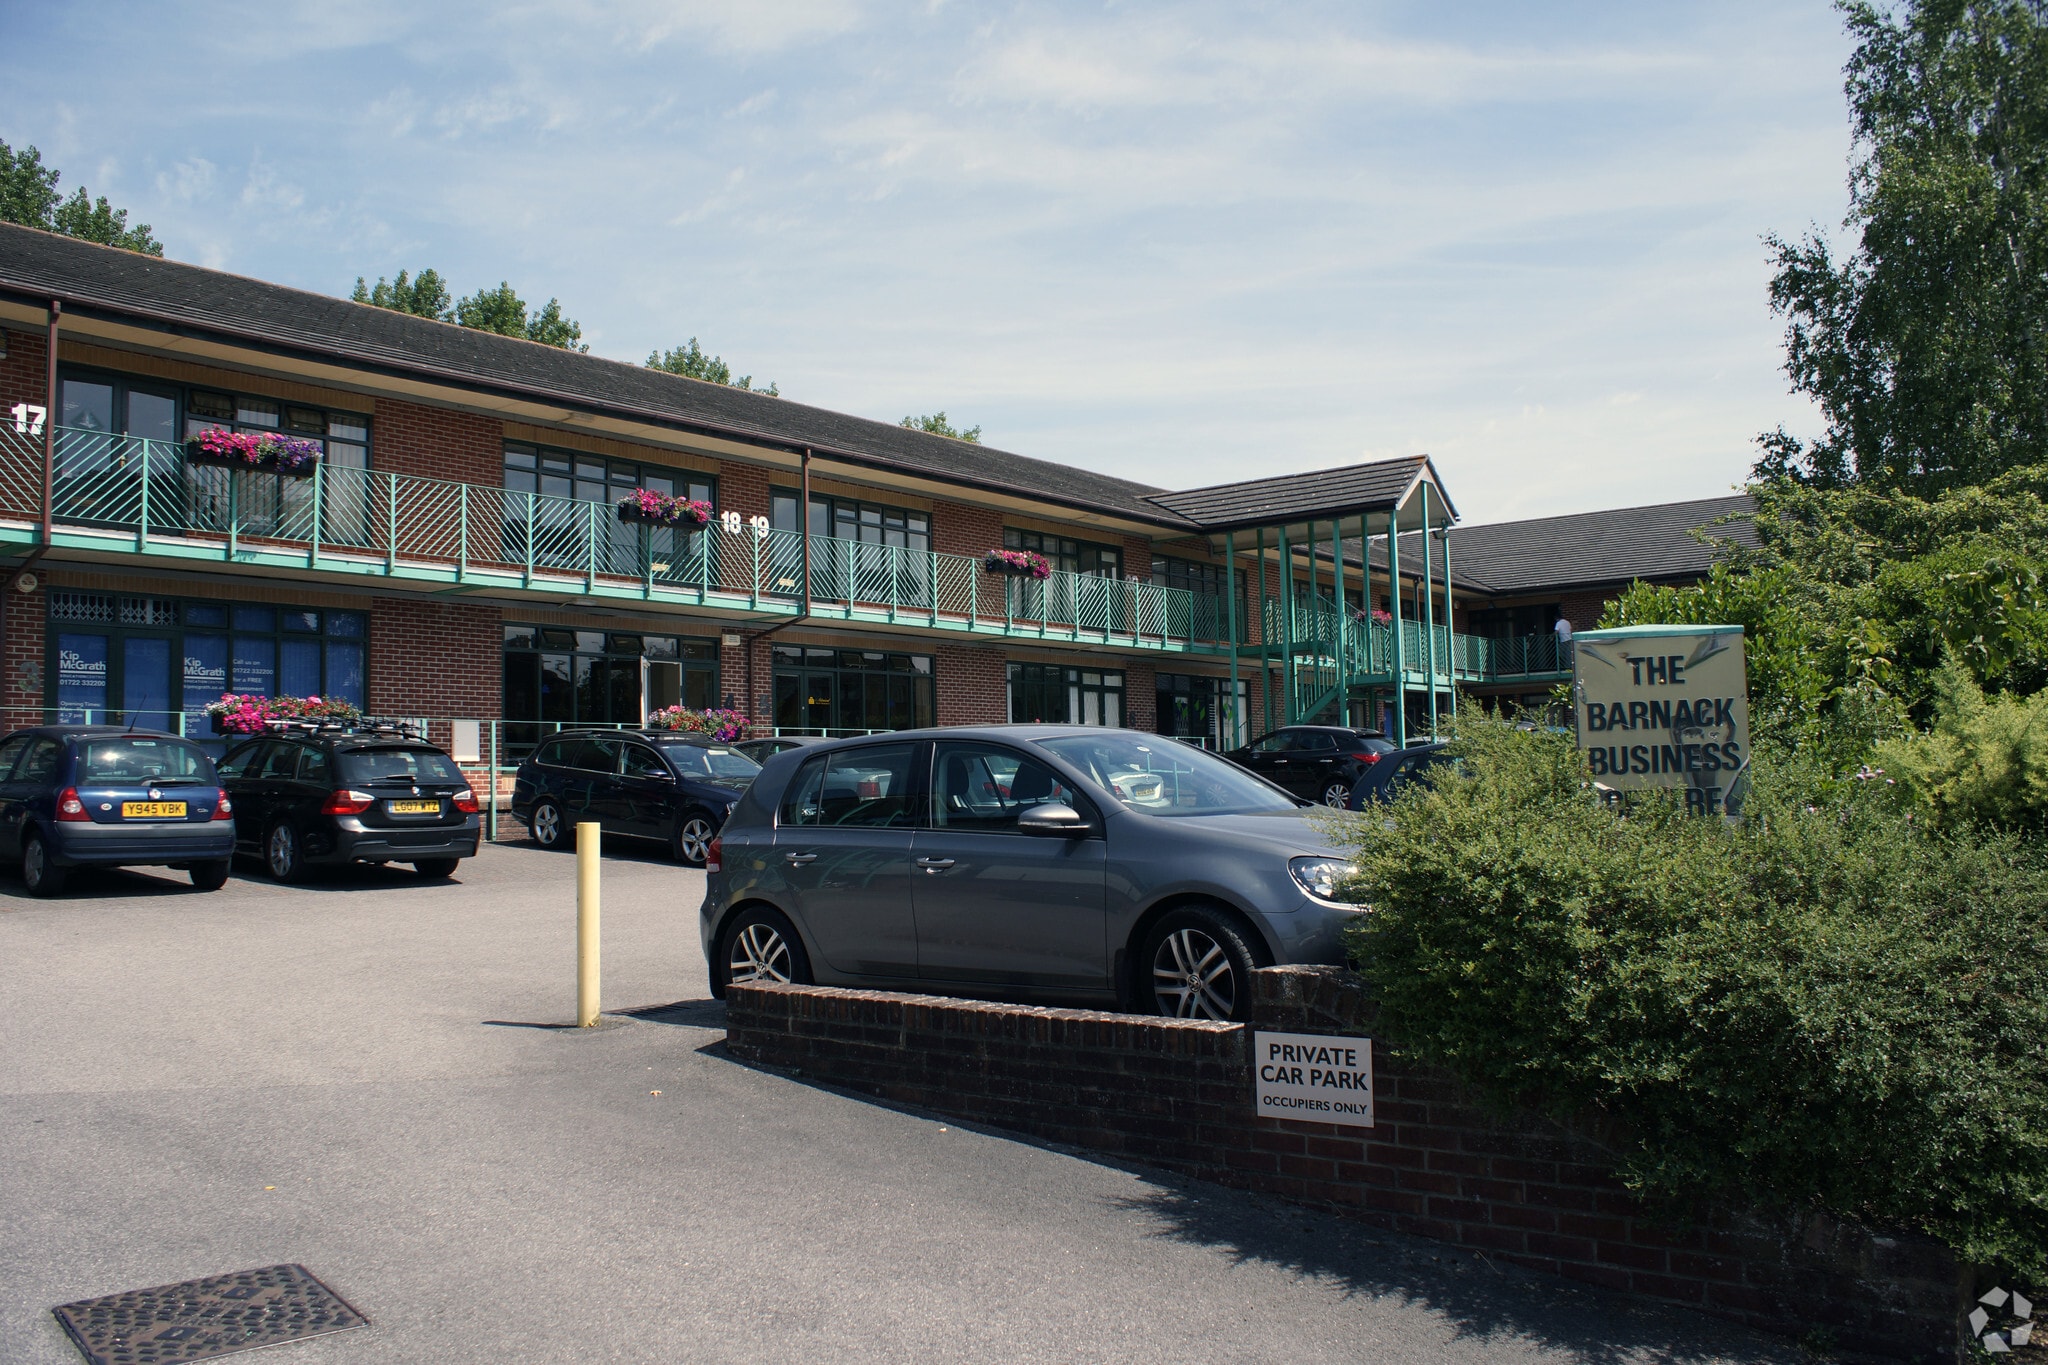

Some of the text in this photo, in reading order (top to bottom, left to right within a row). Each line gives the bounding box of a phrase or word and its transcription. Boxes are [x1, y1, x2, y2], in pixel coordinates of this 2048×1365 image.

[11, 403, 46, 435] 17
[721, 511, 741, 534] 18
[750, 515, 769, 538] 19
[60, 650, 79, 662] Kip
[60, 660, 106, 671] McGrath
[184, 657, 201, 669] Kip
[18, 662, 40, 691] 3
[184, 667, 225, 676] McGrath
[1626, 655, 1685, 686] THE
[1587, 698, 1737, 731] BARNACK
[1588, 742, 1741, 775] BUSINESS
[128, 804, 182, 814] Y945 VBK
[395, 802, 417, 811] LG07
[1270, 1043, 1356, 1067] PRIVATE
[1261, 1065, 1368, 1091] CAR PARK
[1263, 1095, 1367, 1115] OCCUPIERS ONLY
